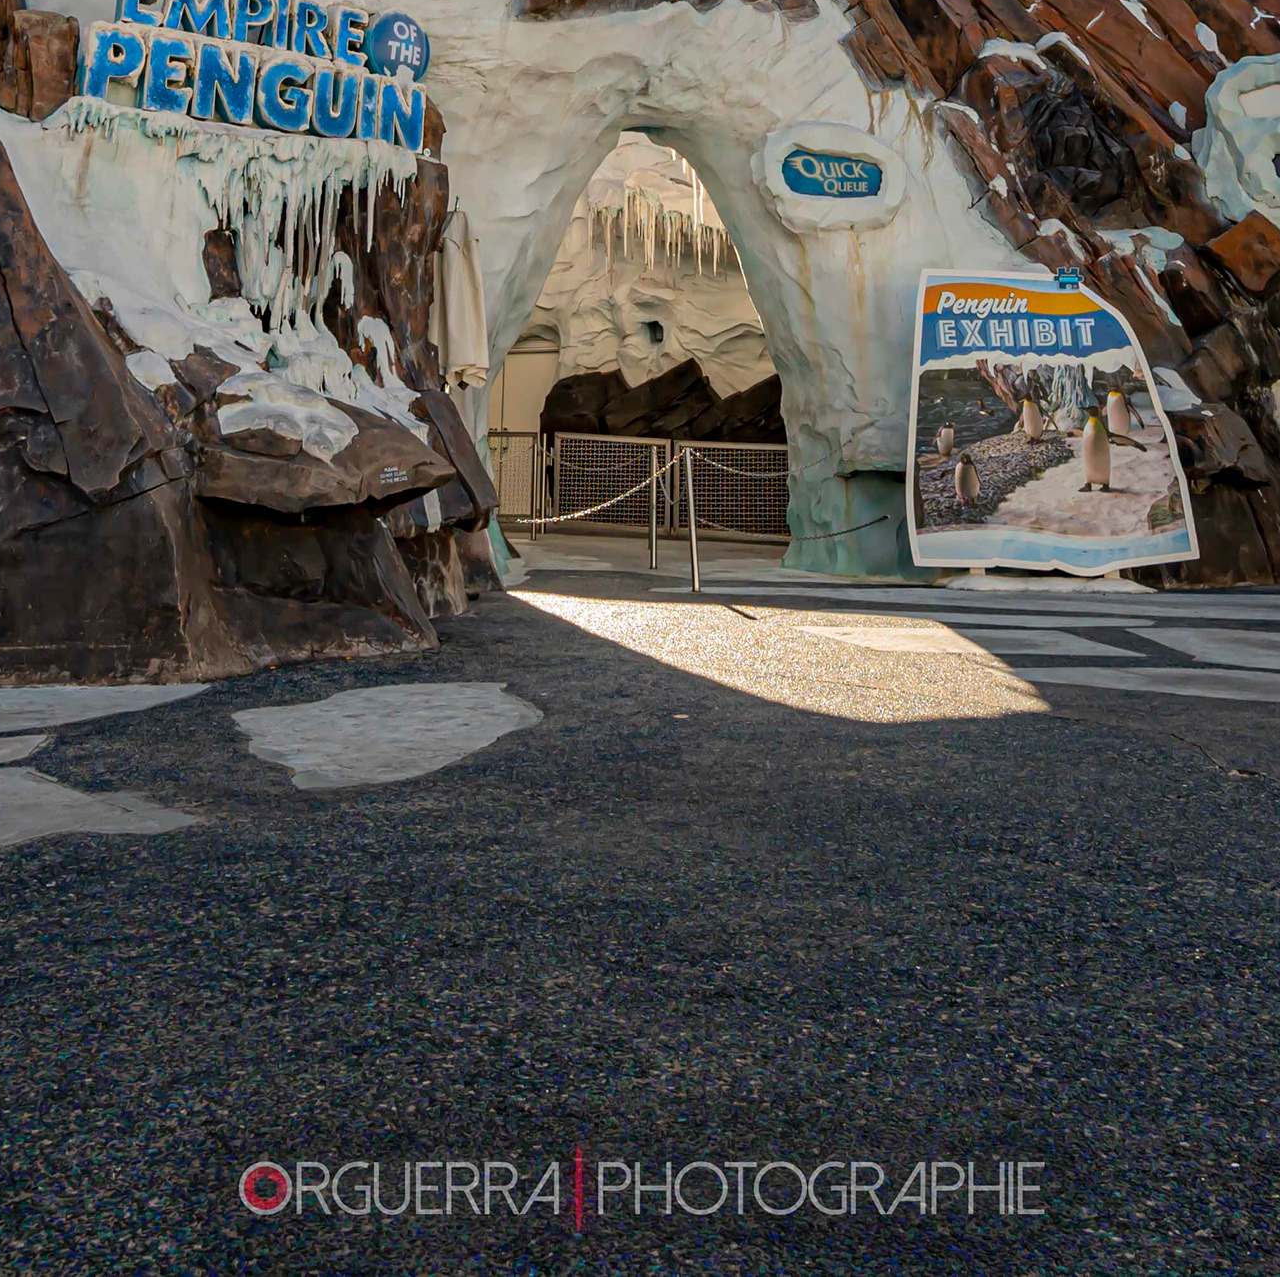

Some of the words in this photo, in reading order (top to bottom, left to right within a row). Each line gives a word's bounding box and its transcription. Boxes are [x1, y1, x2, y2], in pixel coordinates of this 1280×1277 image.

[393, 21, 418, 43] OF
[387, 40, 421, 66] THE
[83, 23, 426, 153] PENGUIN
[788, 155, 868, 181] QUICK
[823, 178, 869, 194] QUEUE
[936, 291, 1028, 319] Penguin
[937, 318, 1095, 349] EXHIBIT
